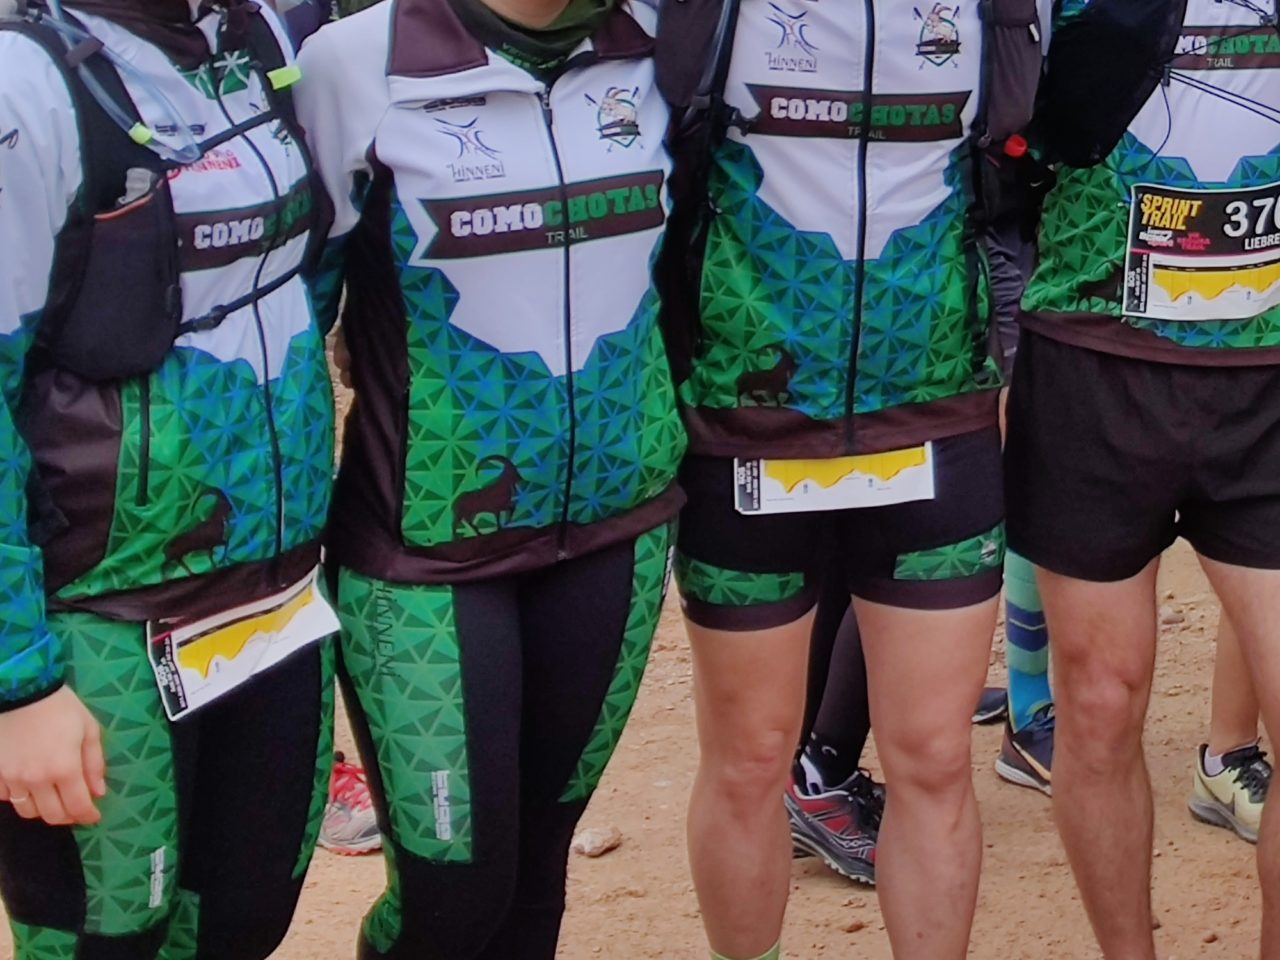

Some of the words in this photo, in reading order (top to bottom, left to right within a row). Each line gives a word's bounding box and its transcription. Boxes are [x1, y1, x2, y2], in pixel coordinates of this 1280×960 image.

[770, 96, 957, 127] COMOCHOTAS
[449, 184, 659, 239] COMOCHOTAS
[1141, 193, 1203, 218] SPRINT
[1141, 208, 1187, 230] TRAIL
[545, 230, 589, 244] TRAIL
